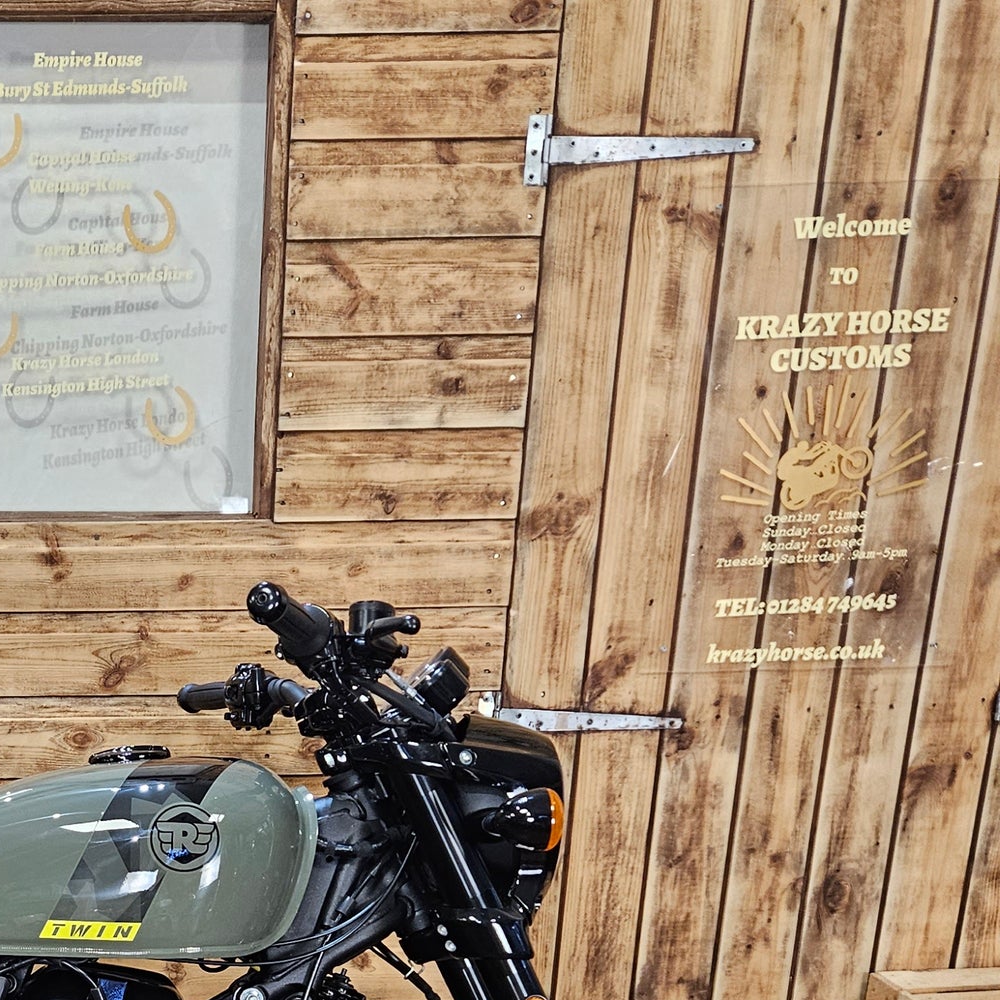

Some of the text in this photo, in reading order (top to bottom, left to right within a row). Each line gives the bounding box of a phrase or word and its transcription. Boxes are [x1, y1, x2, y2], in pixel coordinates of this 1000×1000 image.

[33, 50, 143, 72] Empire House
[33, 80, 51, 97] St
[793, 212, 913, 240] Welcome
[829, 266, 860, 286] TO
[735, 307, 951, 341] KRAZY HORSE
[11, 350, 160, 374] Krazy Horse London
[770, 343, 913, 373] CUSTOMS
[1, 372, 170, 398] Kensington High Street
[762, 509, 869, 527] Opening Times
[706, 637, 886, 669] krazyhorse.co.uk
[52, 923, 133, 938] TWIN
